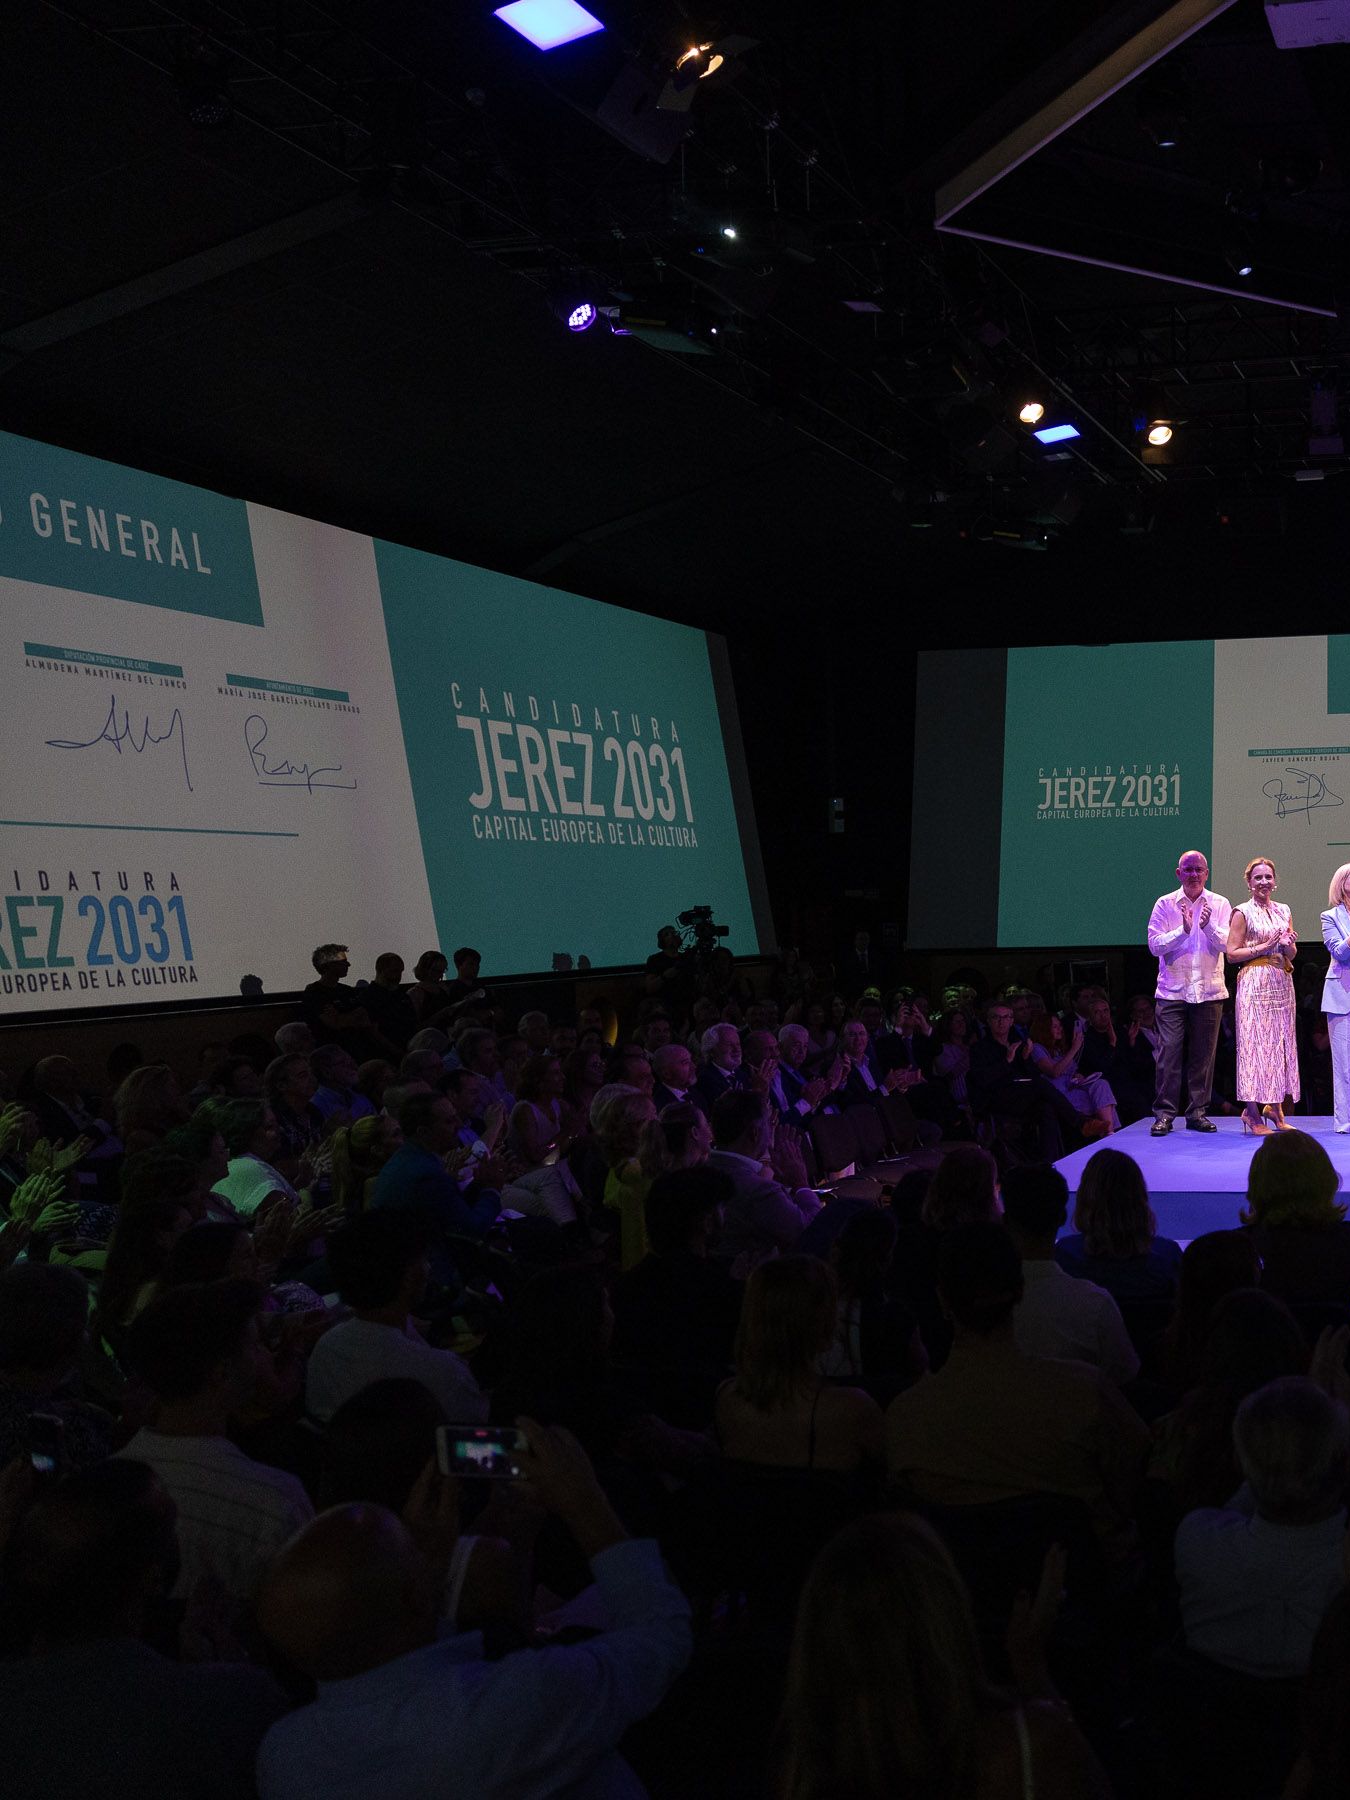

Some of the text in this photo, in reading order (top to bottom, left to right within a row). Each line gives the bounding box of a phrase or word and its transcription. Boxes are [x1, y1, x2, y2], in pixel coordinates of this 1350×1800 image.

[30, 492, 212, 574] GENERAL
[25, 658, 188, 690] ALMUDENA MARTÍNEZ DEL JUNCO
[217, 686, 244, 698] MARÍA
[248, 690, 266, 701] JOSÉ
[451, 682, 680, 743] CANDIDATURA
[456, 714, 606, 816] JEREZ
[604, 736, 694, 822] 2031
[1038, 763, 1180, 777] CANDIDATURA
[1037, 774, 1180, 810] JEREZ 2031
[1037, 807, 1180, 820] CAPITAL EUROPEA DE LA CULTURA
[472, 814, 698, 848] CAPITAL EUROPEA DE LA CULTURA
[78, 894, 194, 966] 2031
[0, 965, 198, 994] UROPEA DE LA CULTURA
